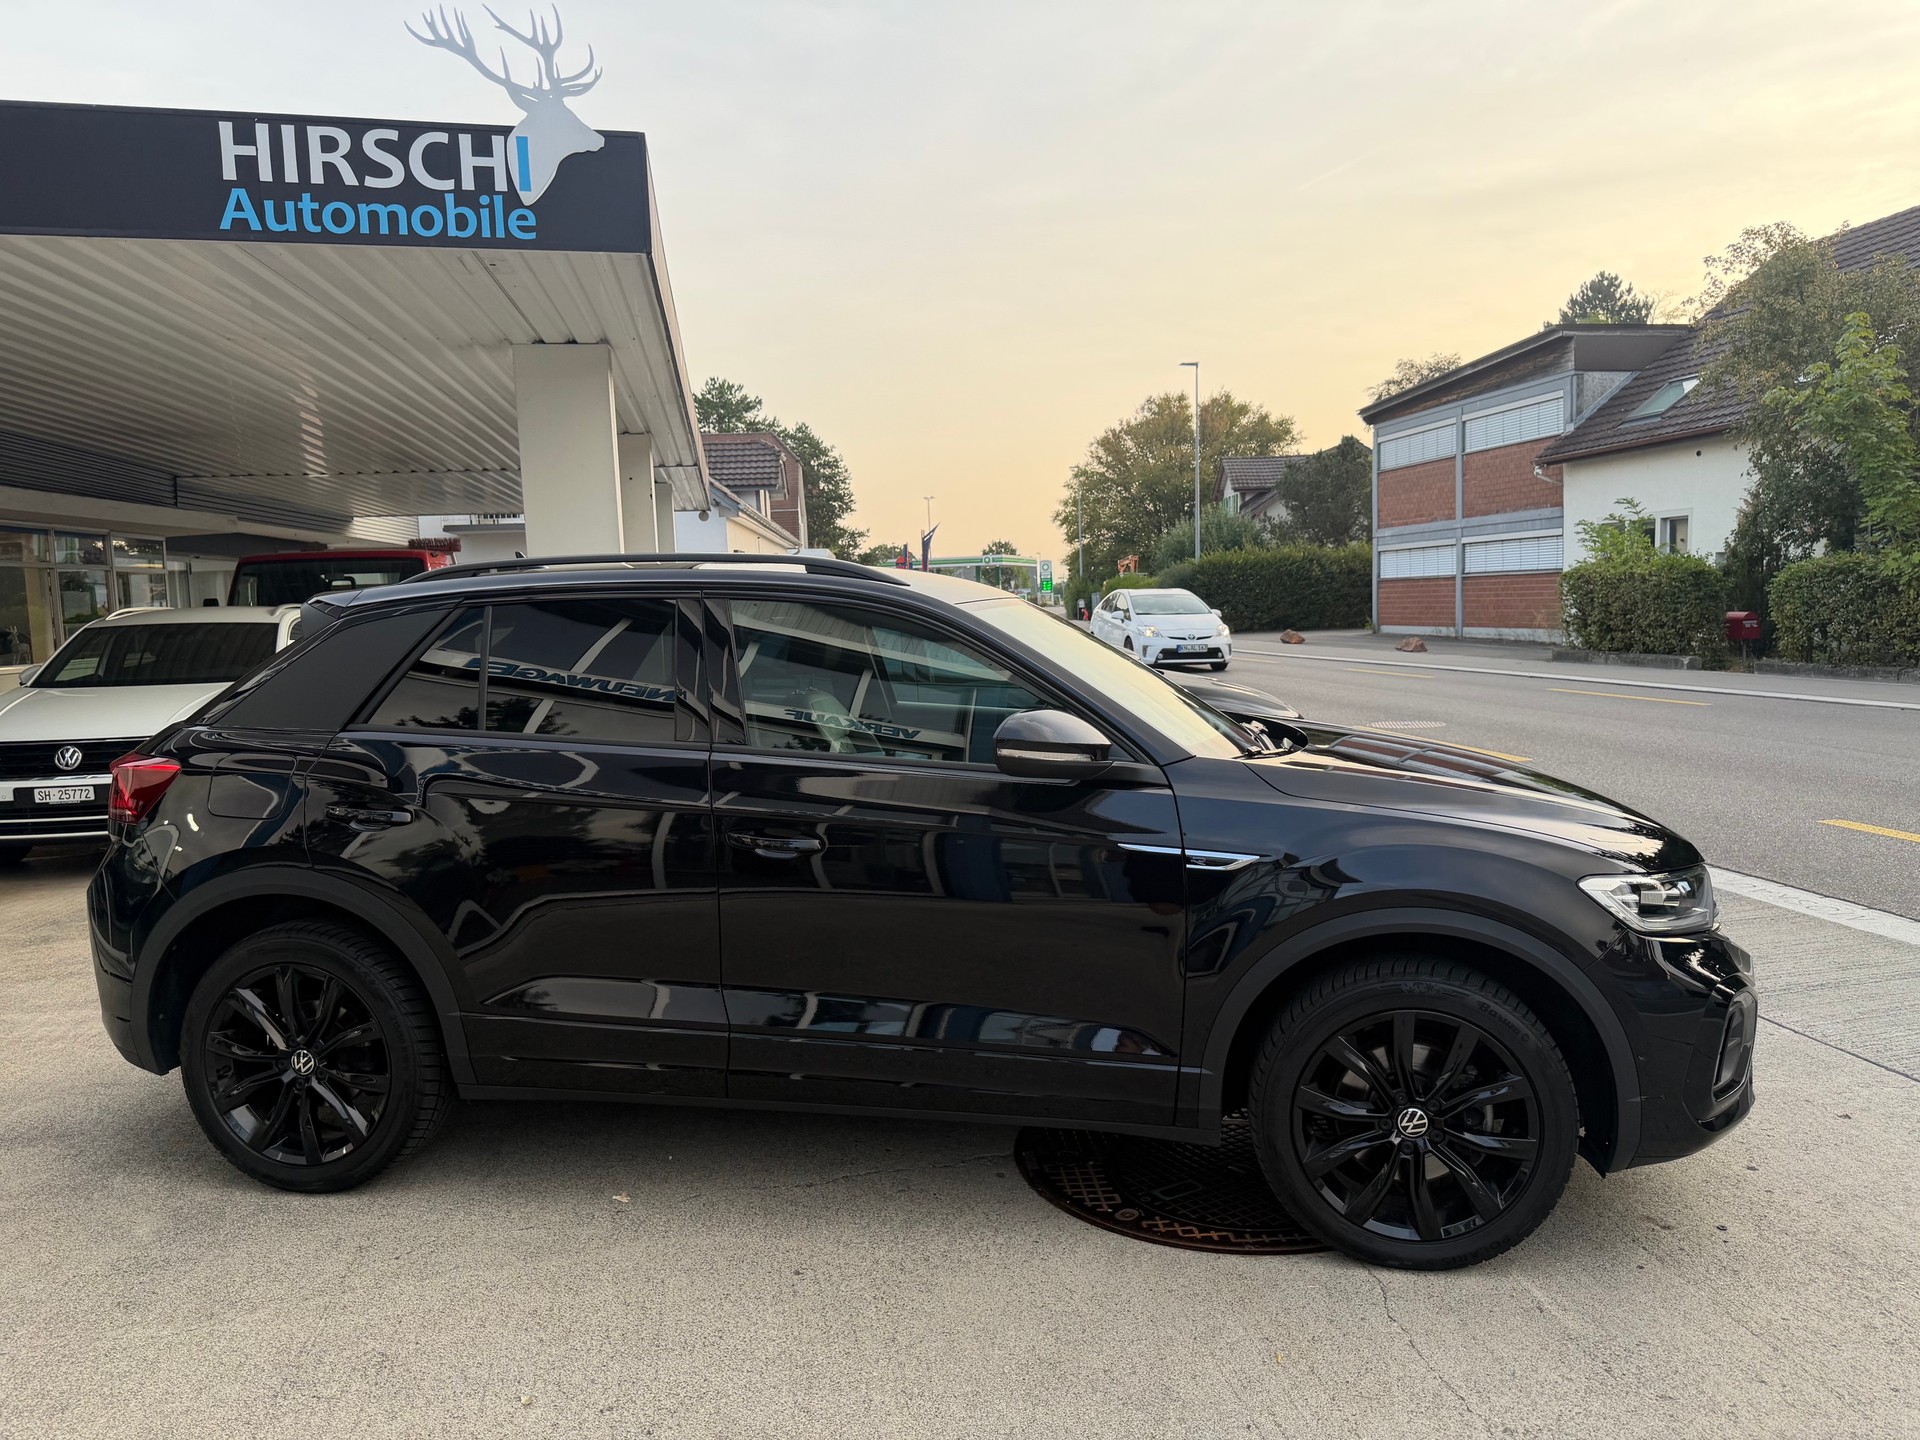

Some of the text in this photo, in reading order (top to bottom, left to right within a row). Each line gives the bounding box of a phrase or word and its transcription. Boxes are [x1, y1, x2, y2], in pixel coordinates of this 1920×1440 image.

[219, 187, 538, 240] Automobile
[54, 745, 83, 771] VW
[290, 1050, 315, 1076] VW
[1397, 1108, 1429, 1138] VW
